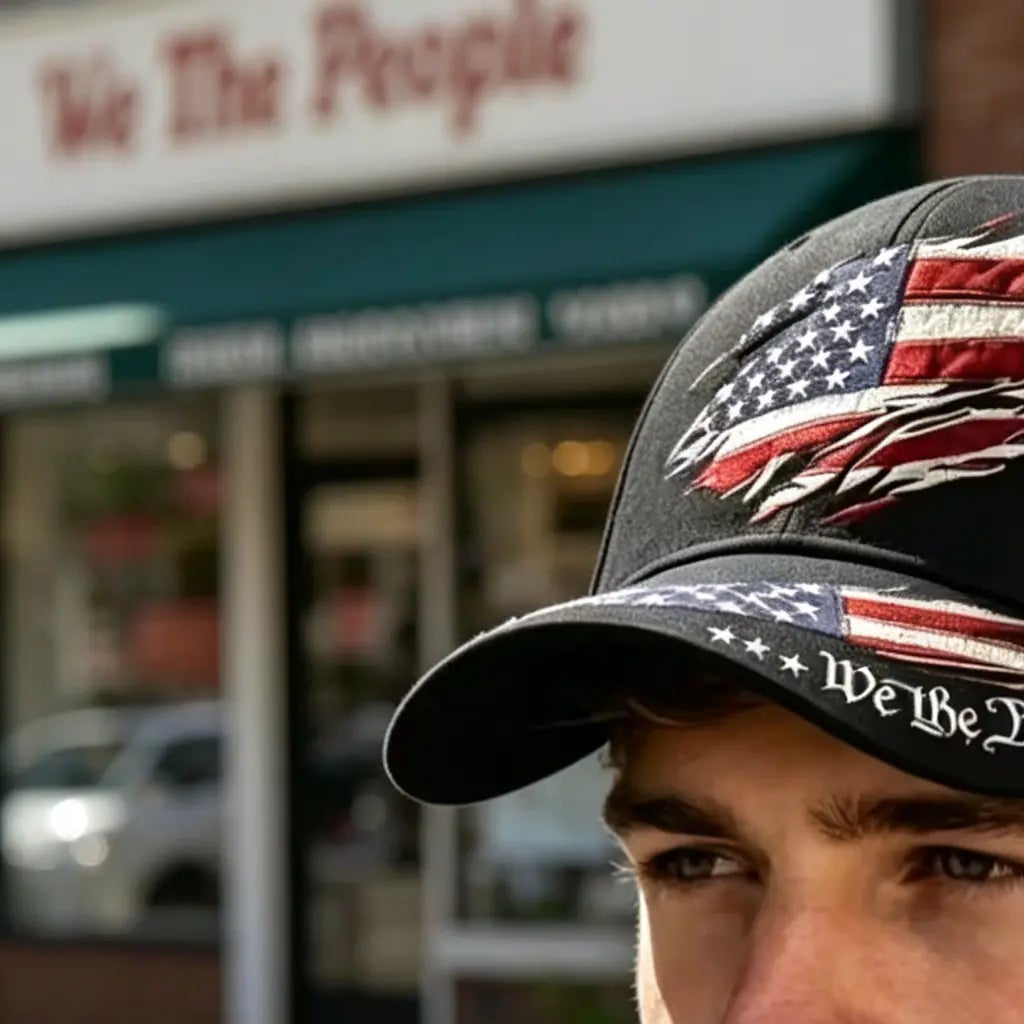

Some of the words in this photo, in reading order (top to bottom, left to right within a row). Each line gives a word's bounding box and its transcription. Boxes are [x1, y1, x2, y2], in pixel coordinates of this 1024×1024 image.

[165, 27, 282, 142] The
[819, 650, 901, 717] We
[881, 679, 982, 746] The
